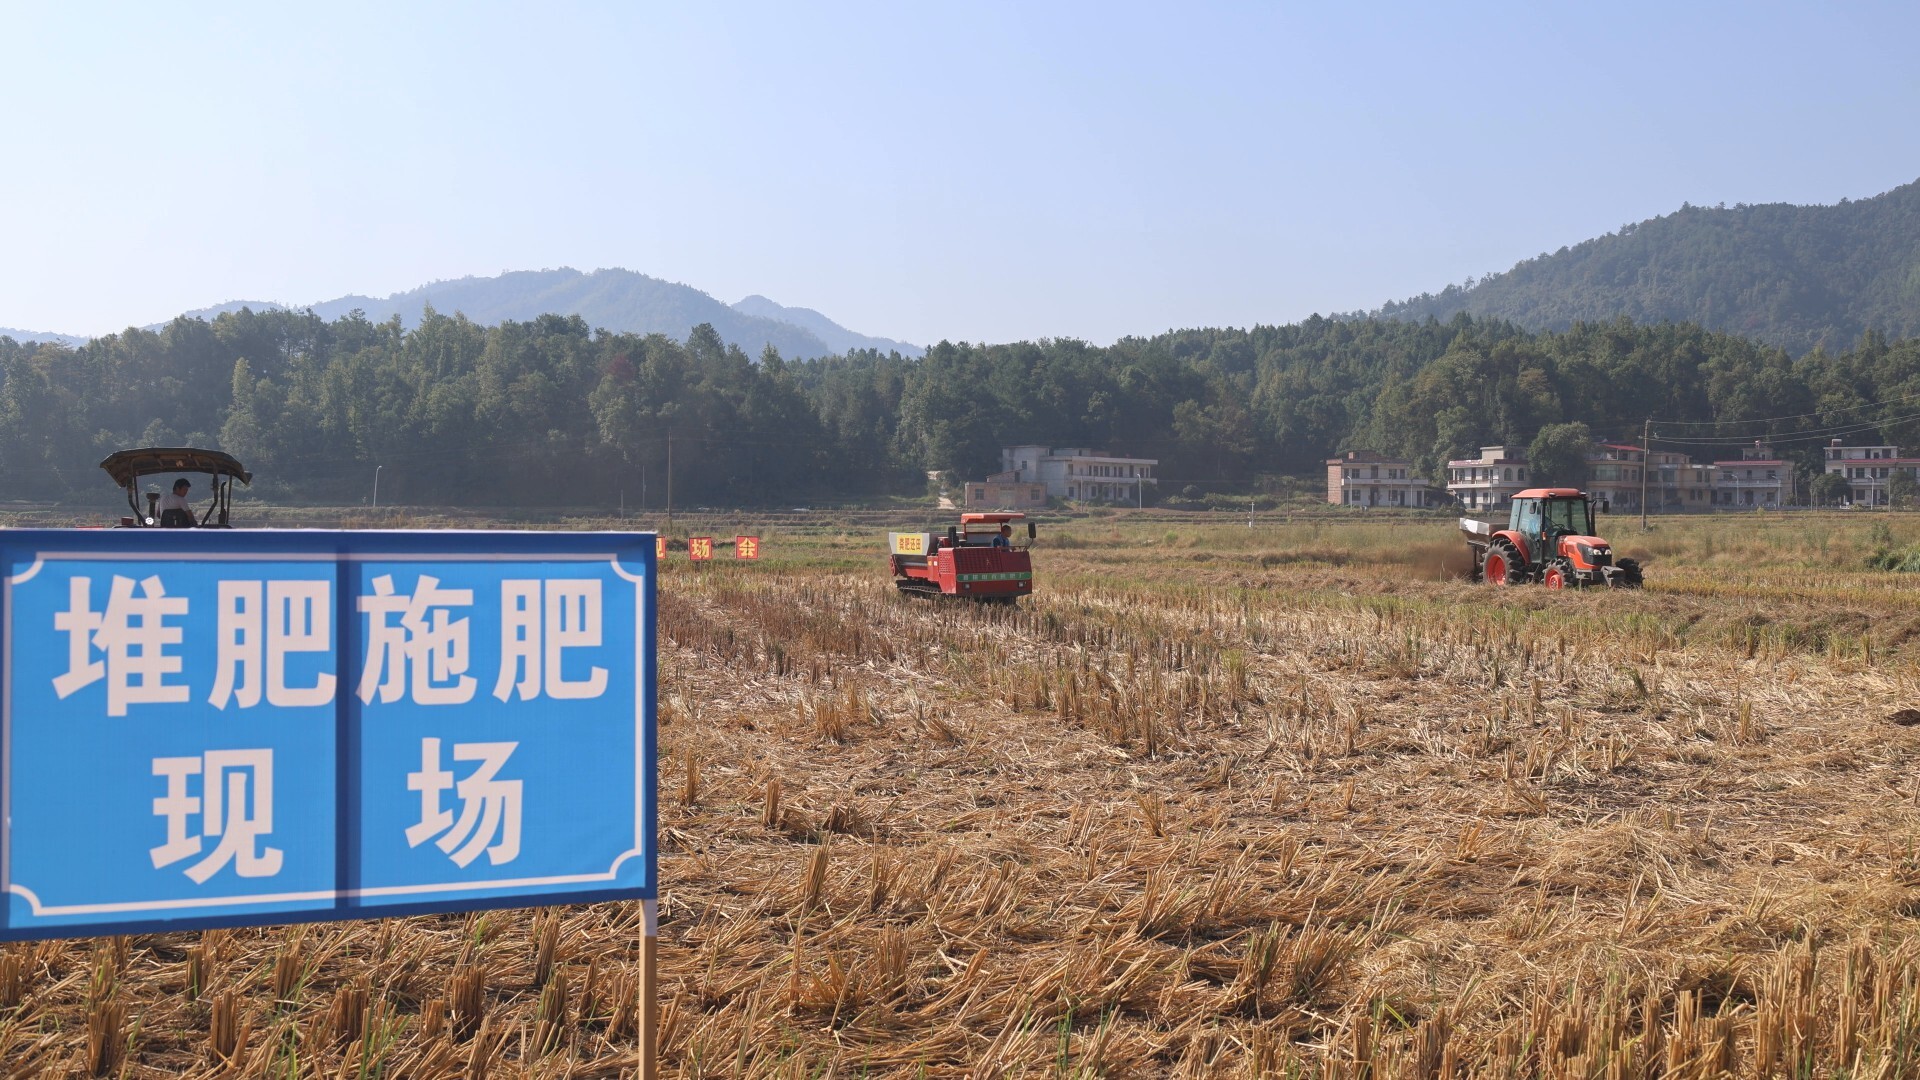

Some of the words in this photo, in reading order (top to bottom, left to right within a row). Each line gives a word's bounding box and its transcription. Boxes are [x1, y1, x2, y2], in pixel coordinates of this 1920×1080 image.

[691, 539, 710, 558] 场
[738, 537, 756, 557] 会
[51, 574, 609, 717] 堆肥施肥
[149, 737, 524, 885] 现场
